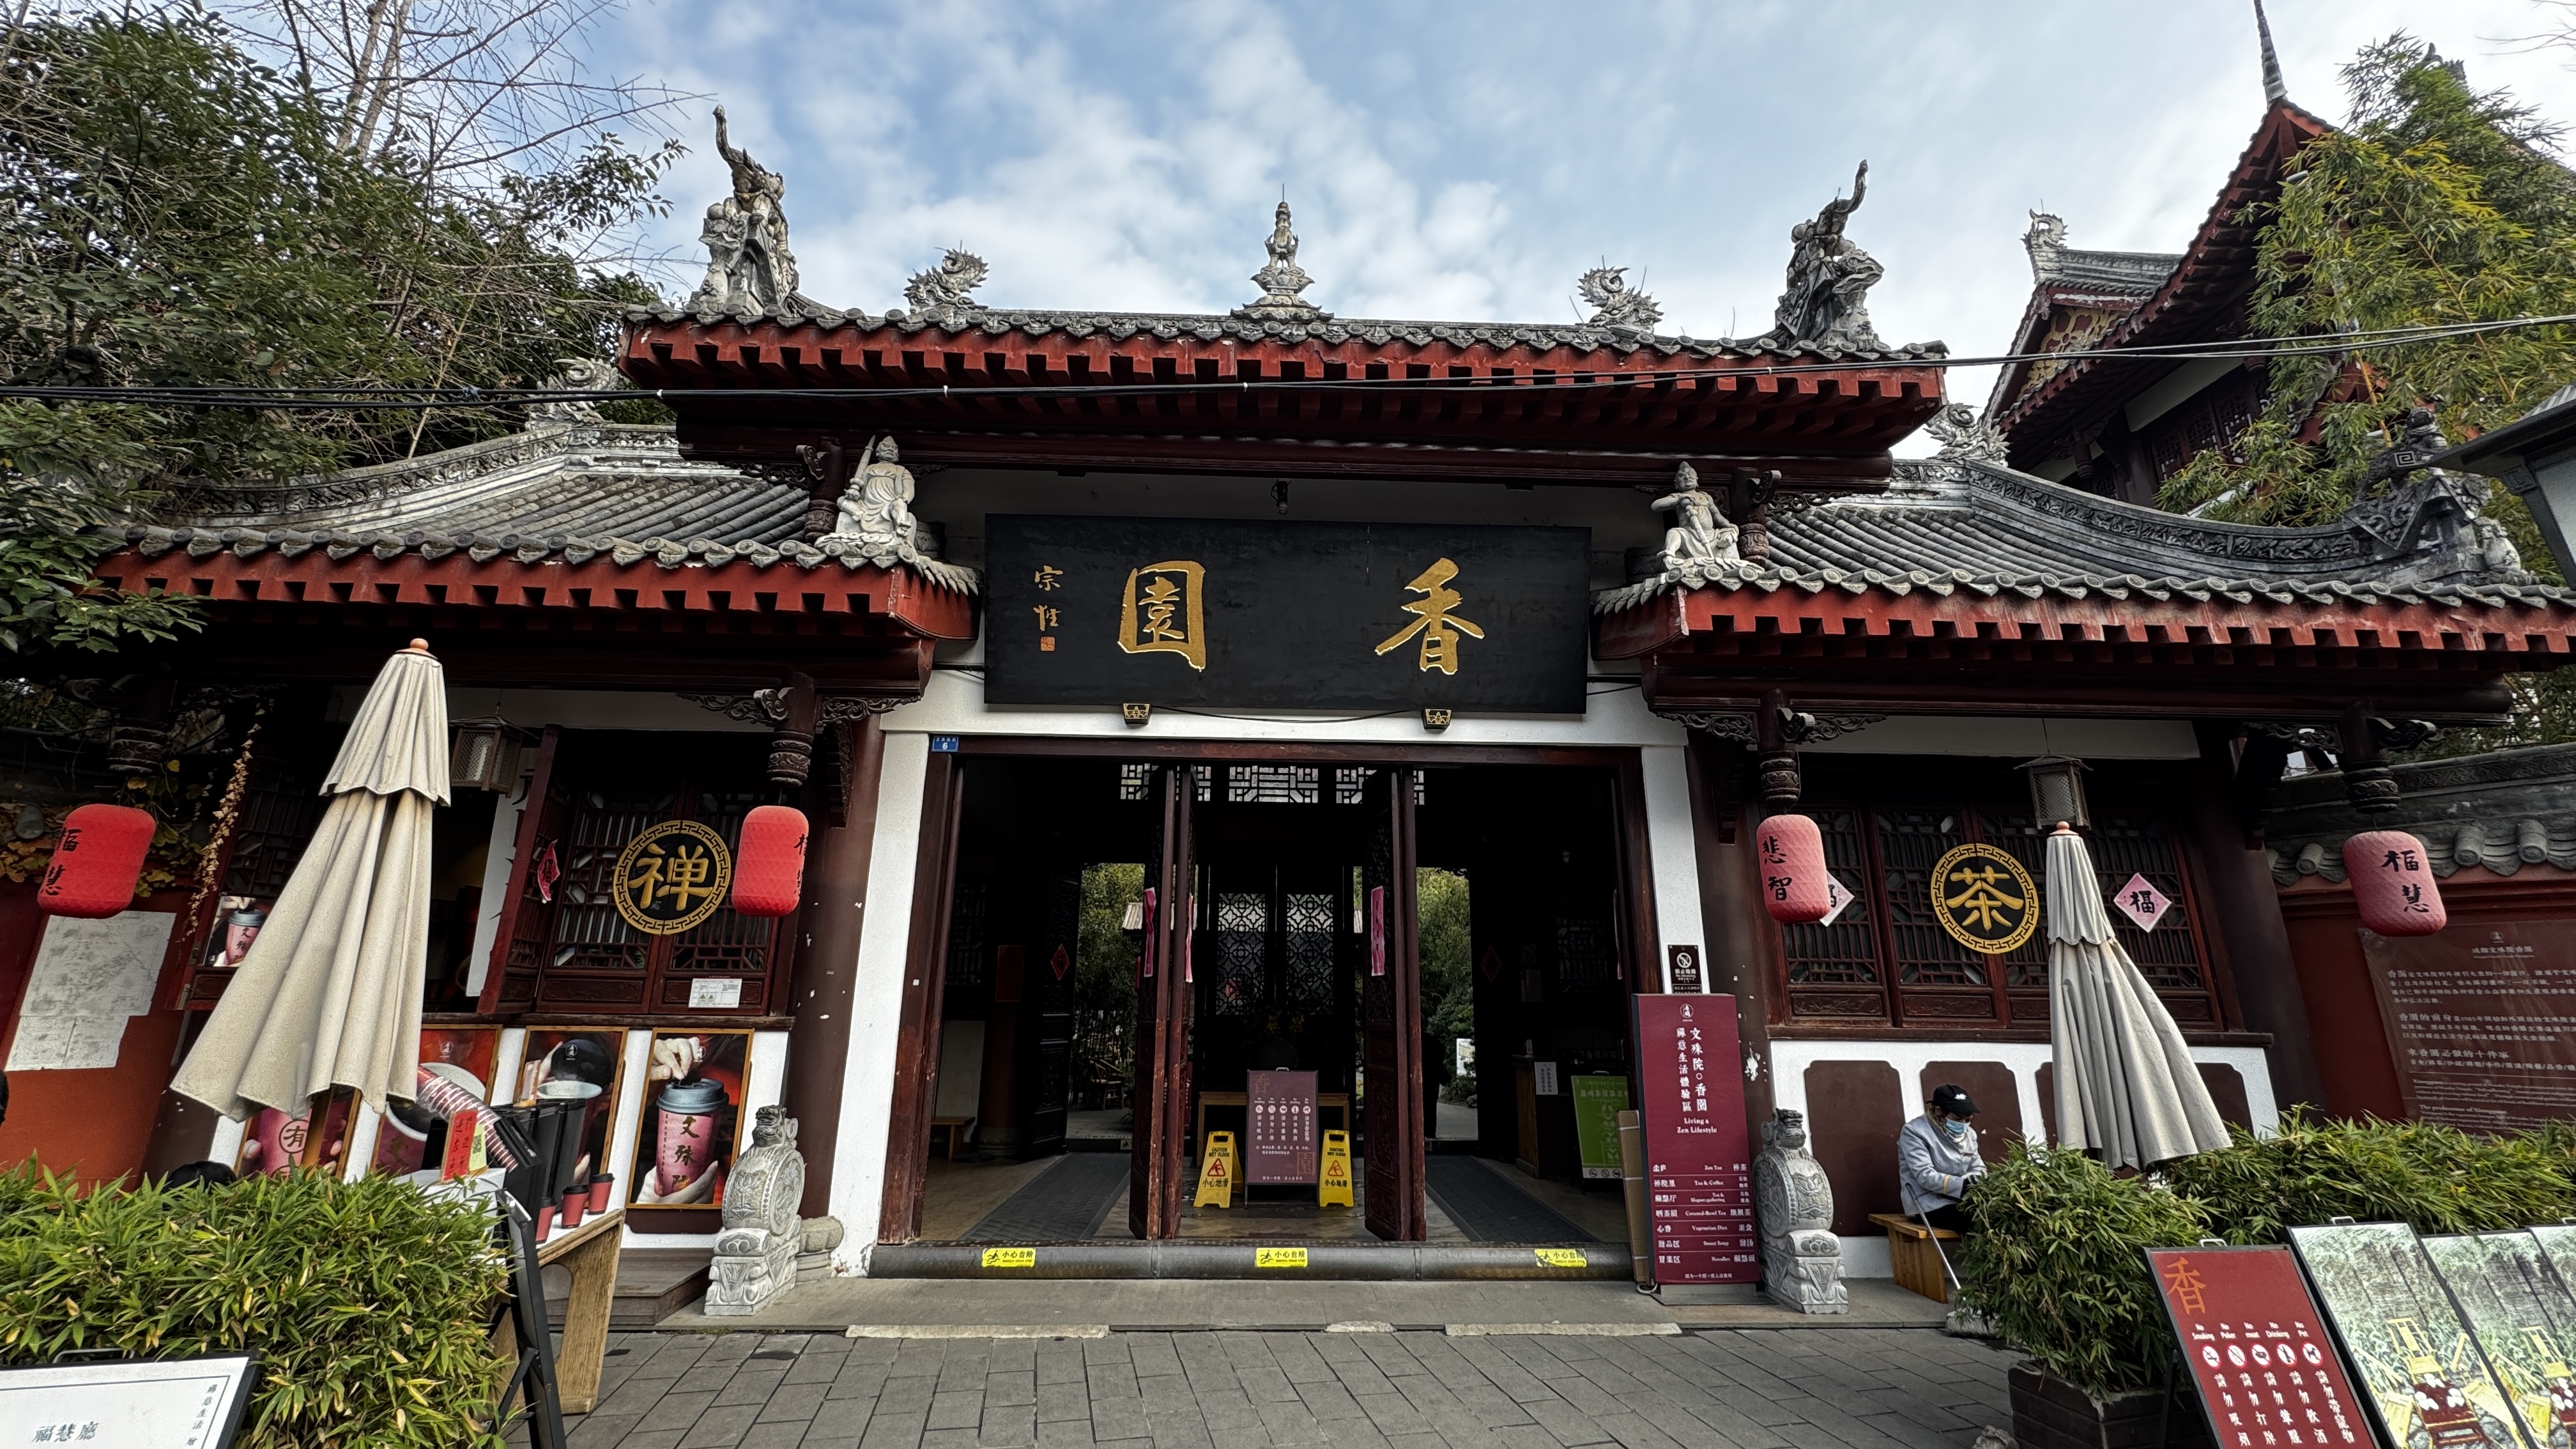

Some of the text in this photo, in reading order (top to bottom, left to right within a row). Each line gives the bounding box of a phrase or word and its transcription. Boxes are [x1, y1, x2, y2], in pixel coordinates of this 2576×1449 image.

[629, 843, 712, 911] 禅
[1762, 836, 1793, 901] 悲智
[2381, 850, 2430, 913] 福慧
[1945, 865, 2024, 931] 茶
[2129, 891, 2155, 914] 福
[284, 1126, 308, 1147] 有
[1202, 1178, 1229, 1187] 小心地滑
[1324, 1179, 1347, 1187] 小心地滑
[2165, 1256, 2206, 1315] 香
[2191, 1331, 2215, 1341] Smoking
[2265, 1330, 2290, 1339] Drinking
